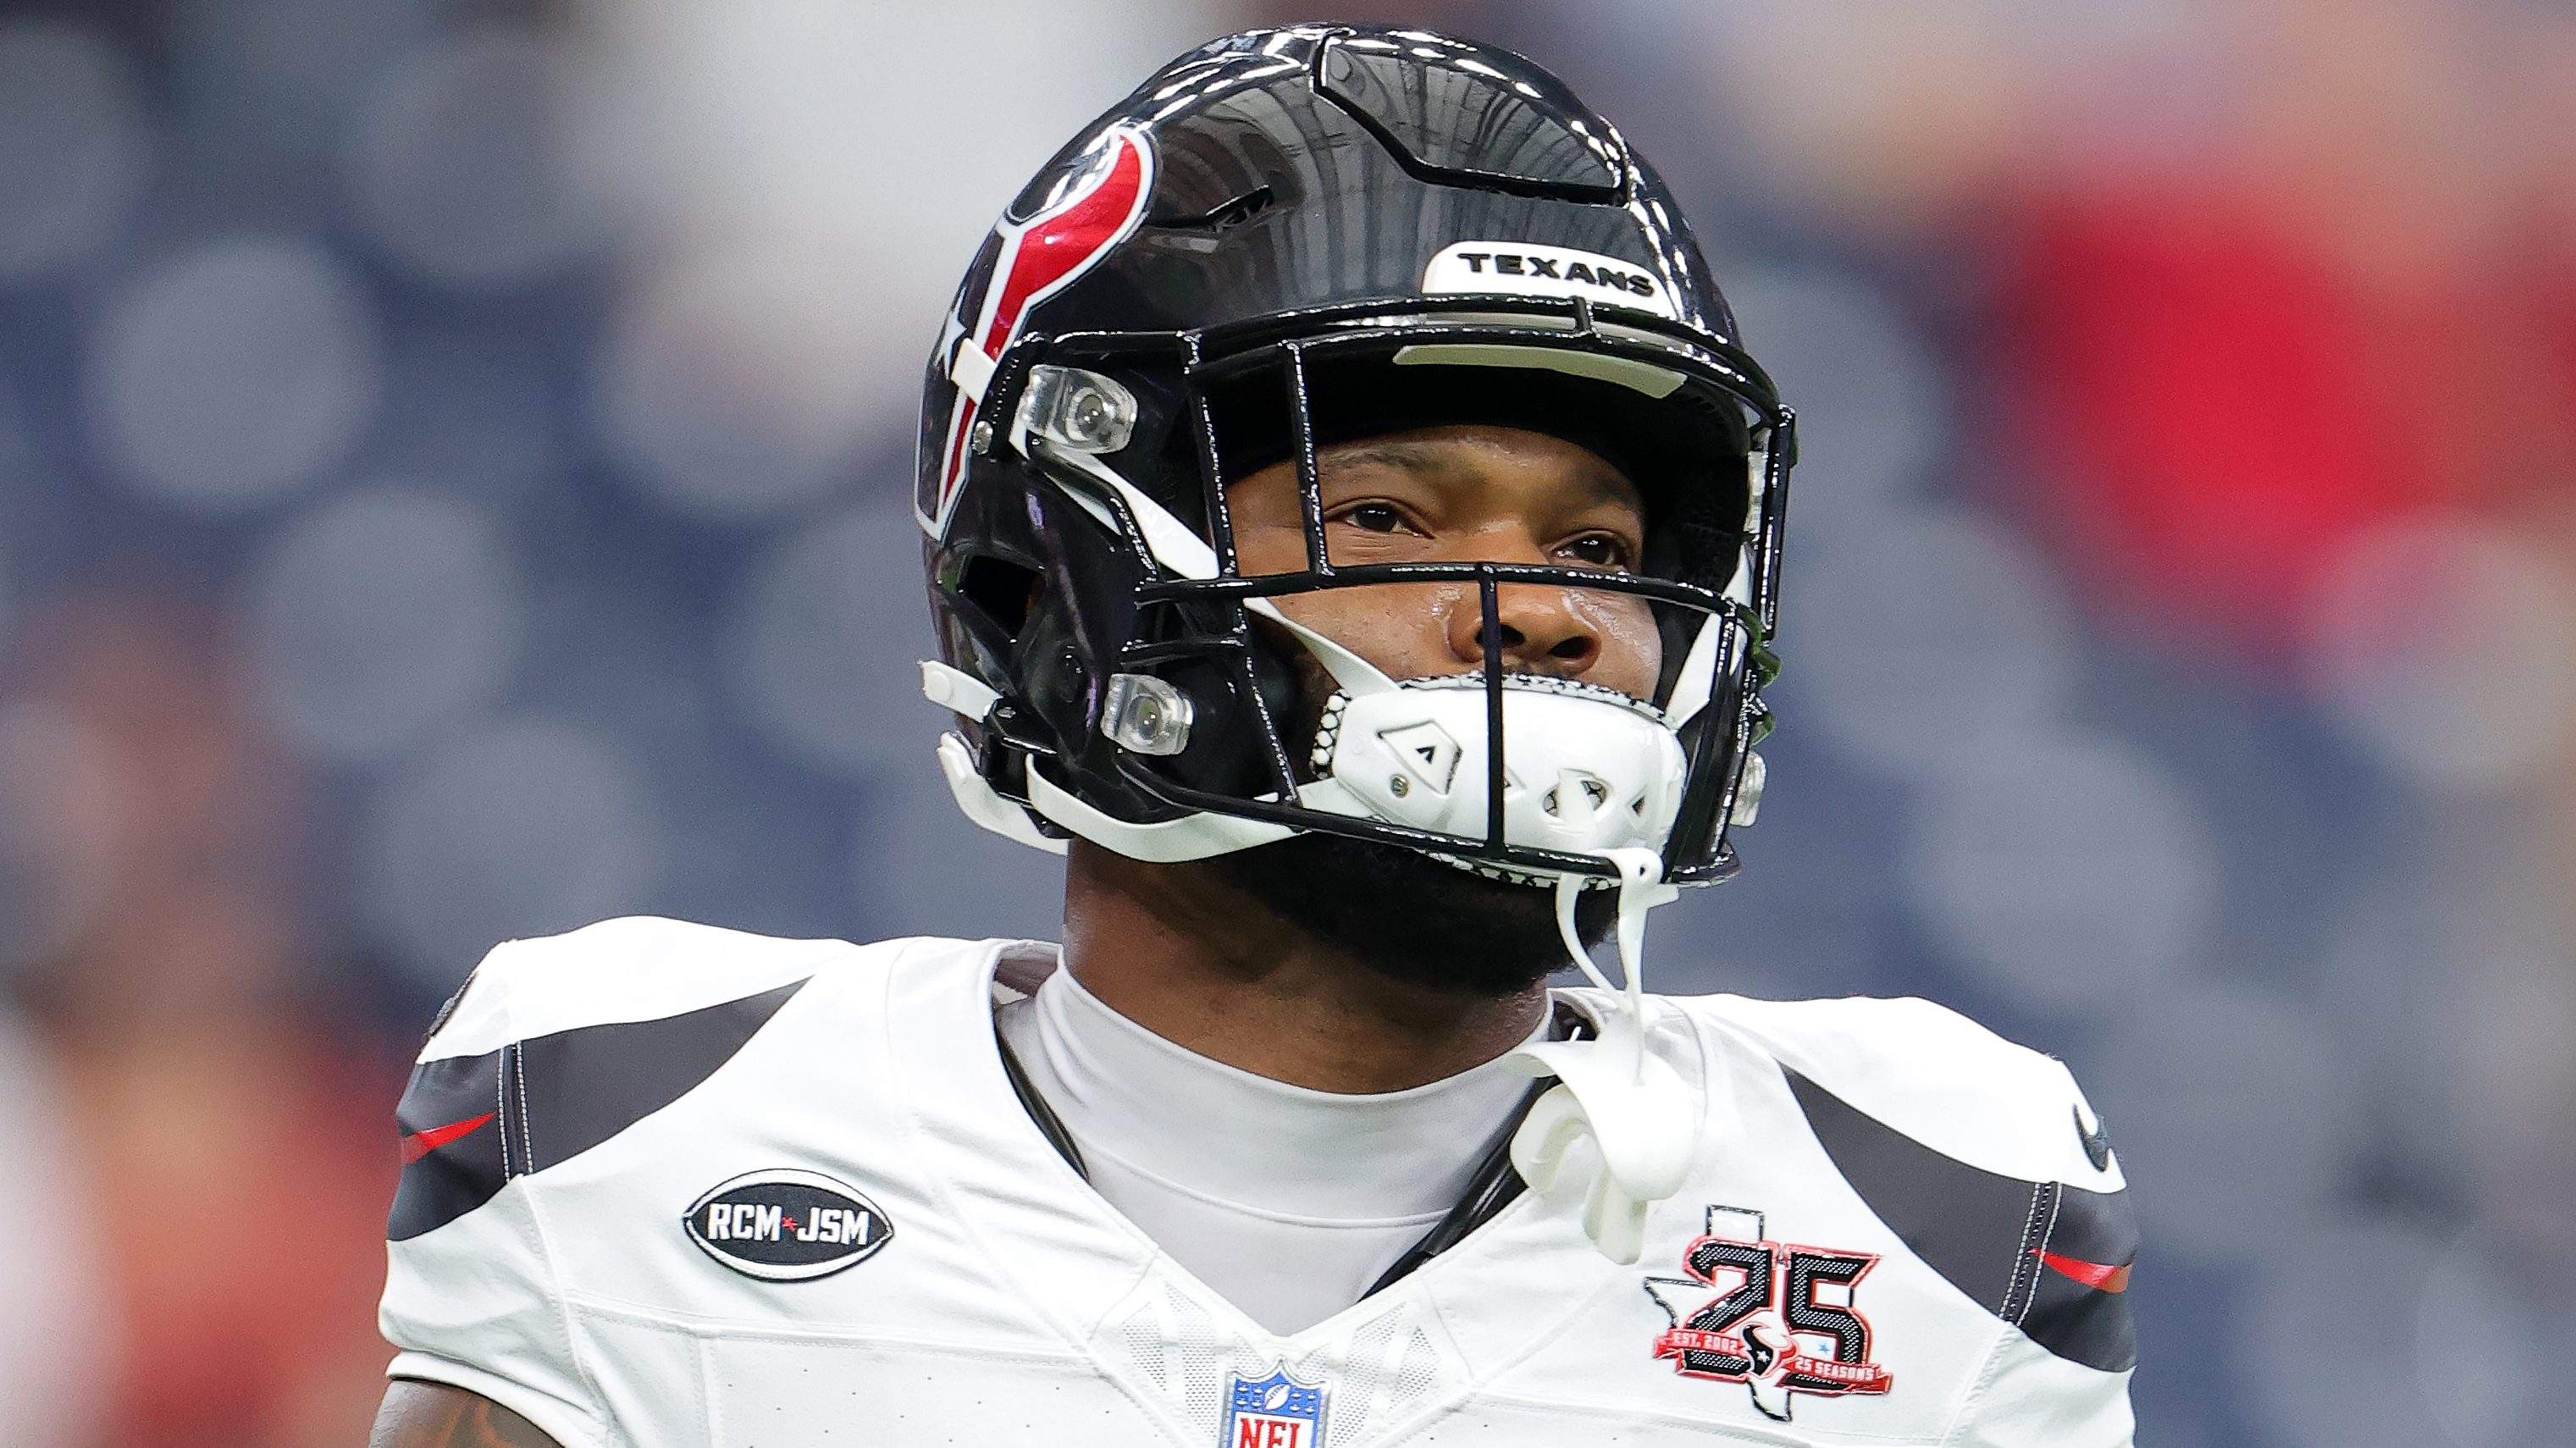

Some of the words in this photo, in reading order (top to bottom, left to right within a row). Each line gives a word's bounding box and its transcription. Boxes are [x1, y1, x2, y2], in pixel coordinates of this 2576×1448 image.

[1457, 253, 1656, 297] TEXANS
[708, 1202, 782, 1241] RCM
[797, 1207, 871, 1246] JSM
[1683, 1237, 1874, 1382] 25
[1704, 1335, 1739, 1355] 2002
[1794, 1356, 1813, 1373] 25
[1814, 1360, 1875, 1382] SEASONS
